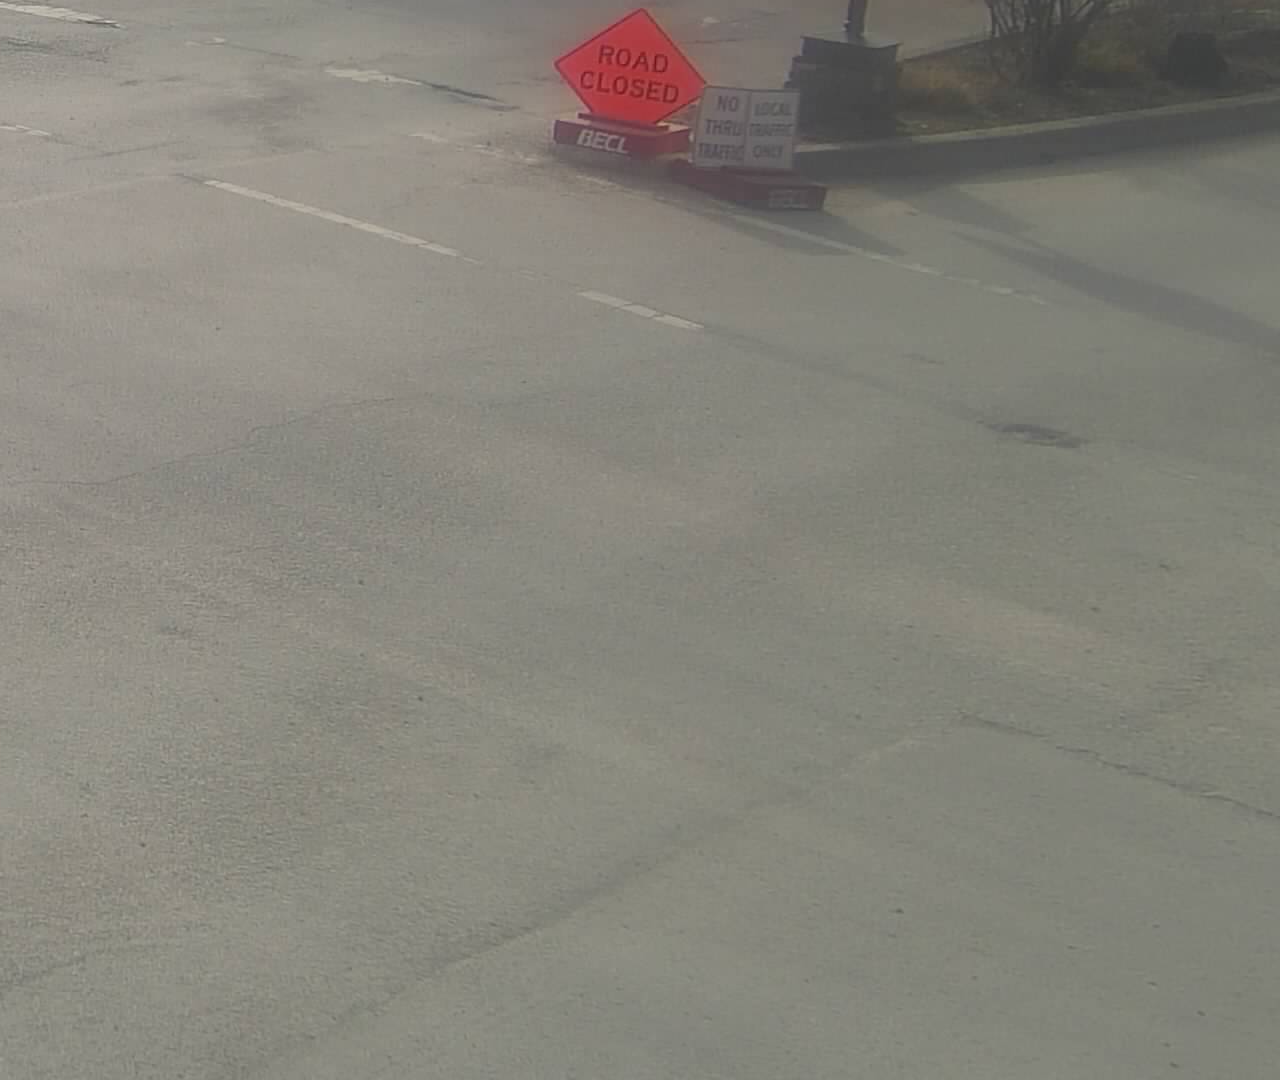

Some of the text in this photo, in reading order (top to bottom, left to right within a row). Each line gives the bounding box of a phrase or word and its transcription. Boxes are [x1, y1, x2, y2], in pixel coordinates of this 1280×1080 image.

[598, 44, 670, 74] ROAD
[579, 70, 680, 104] CLOSED
[716, 95, 741, 113] NO
[754, 101, 792, 117] LOCAL
[705, 119, 743, 137] THRU
[577, 128, 632, 155] BECL
